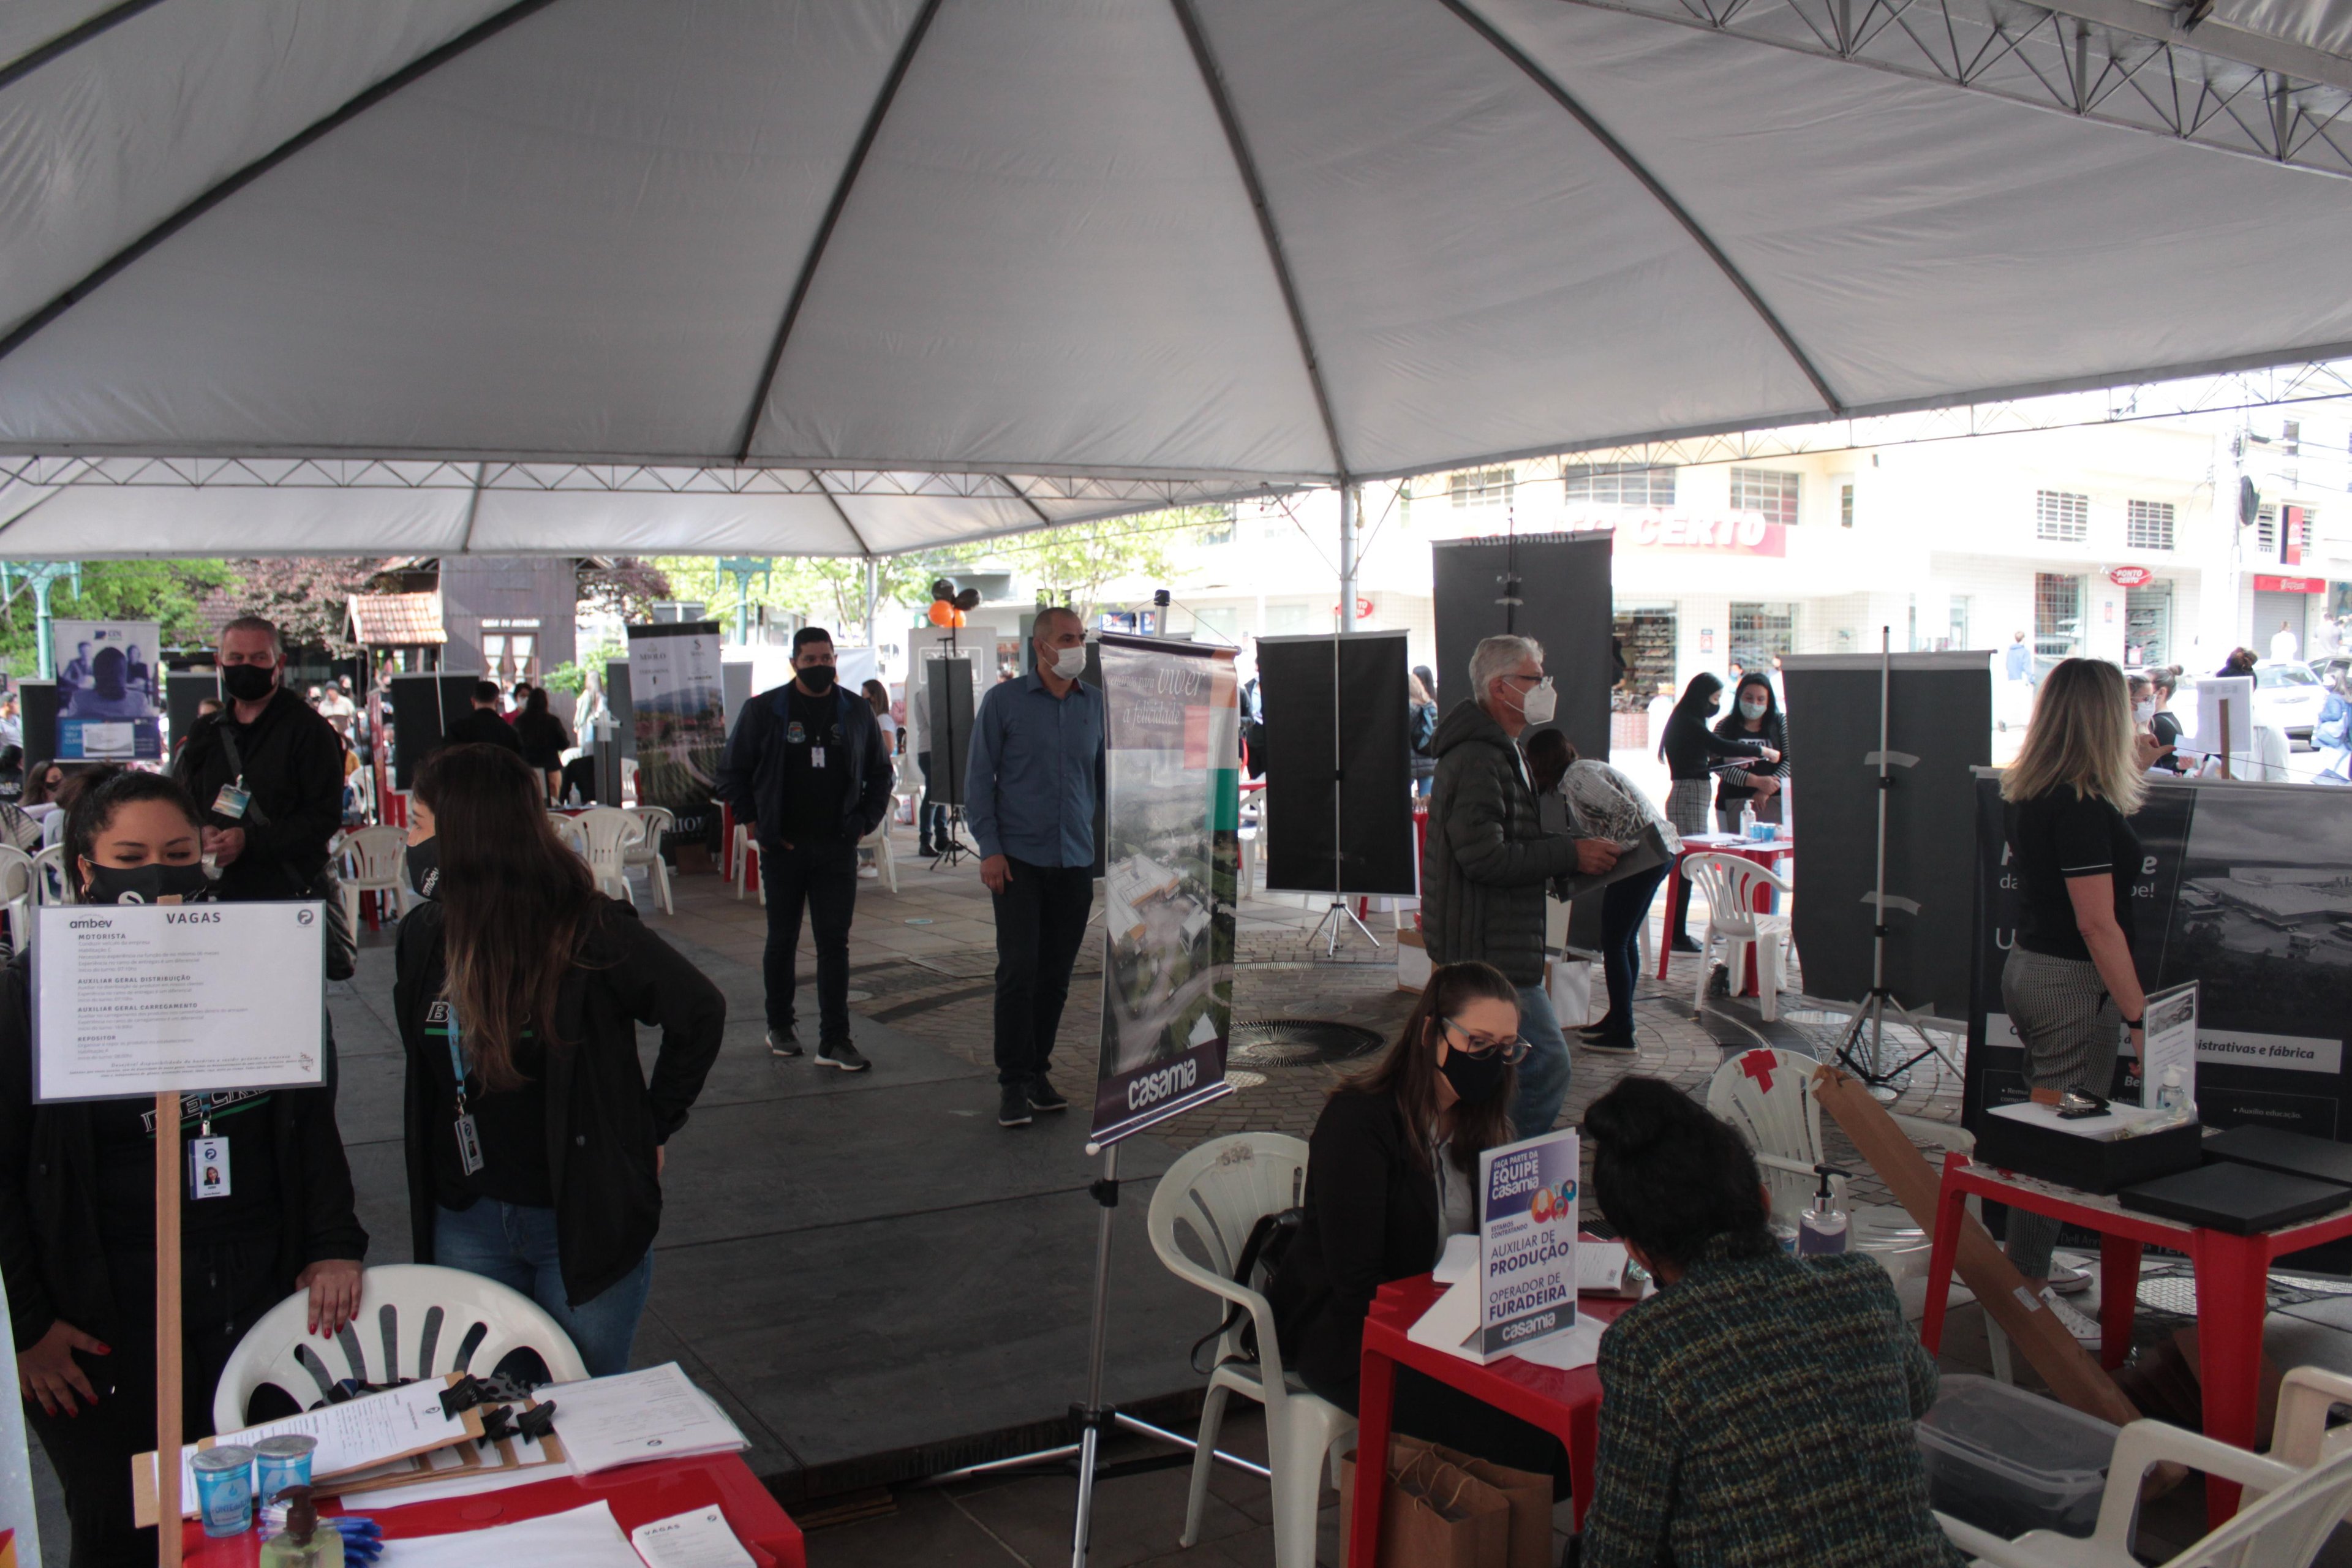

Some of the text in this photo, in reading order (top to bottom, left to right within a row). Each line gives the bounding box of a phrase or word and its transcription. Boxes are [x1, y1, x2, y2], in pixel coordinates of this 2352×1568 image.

[1629, 508, 1766, 546] CERTO
[1137, 676, 1155, 692] para
[1158, 668, 1205, 696] viver
[1123, 700, 1180, 731] a felicidade
[69, 919, 113, 929] ambev
[166, 912, 221, 924] VAGAS
[140, 974, 190, 983] DISTRIBUIÇÃO
[2268, 1045, 2315, 1060] fábrica
[1128, 1058, 1197, 1111] casamia
[2239, 1107, 2303, 1120] Auxílio educação.
[1493, 1150, 1539, 1170] FAÇA PARTE DA
[1492, 1159, 1539, 1186] EQUIPE
[1491, 1176, 1539, 1200] casamia
[1491, 1220, 1515, 1233] ESTAMOS
[1491, 1223, 1528, 1240] CONTRATANDO
[1491, 1229, 1556, 1260] AUXILIAR DE
[2082, 1234, 2101, 1247] Ann
[1490, 1237, 1569, 1278] PRODUÇÃO
[1489, 1272, 1561, 1304] OPERADOR DE
[1490, 1284, 1567, 1322] FURADEIRA
[1502, 1311, 1556, 1341] casamia
[644, 1524, 680, 1536] VAGAS
